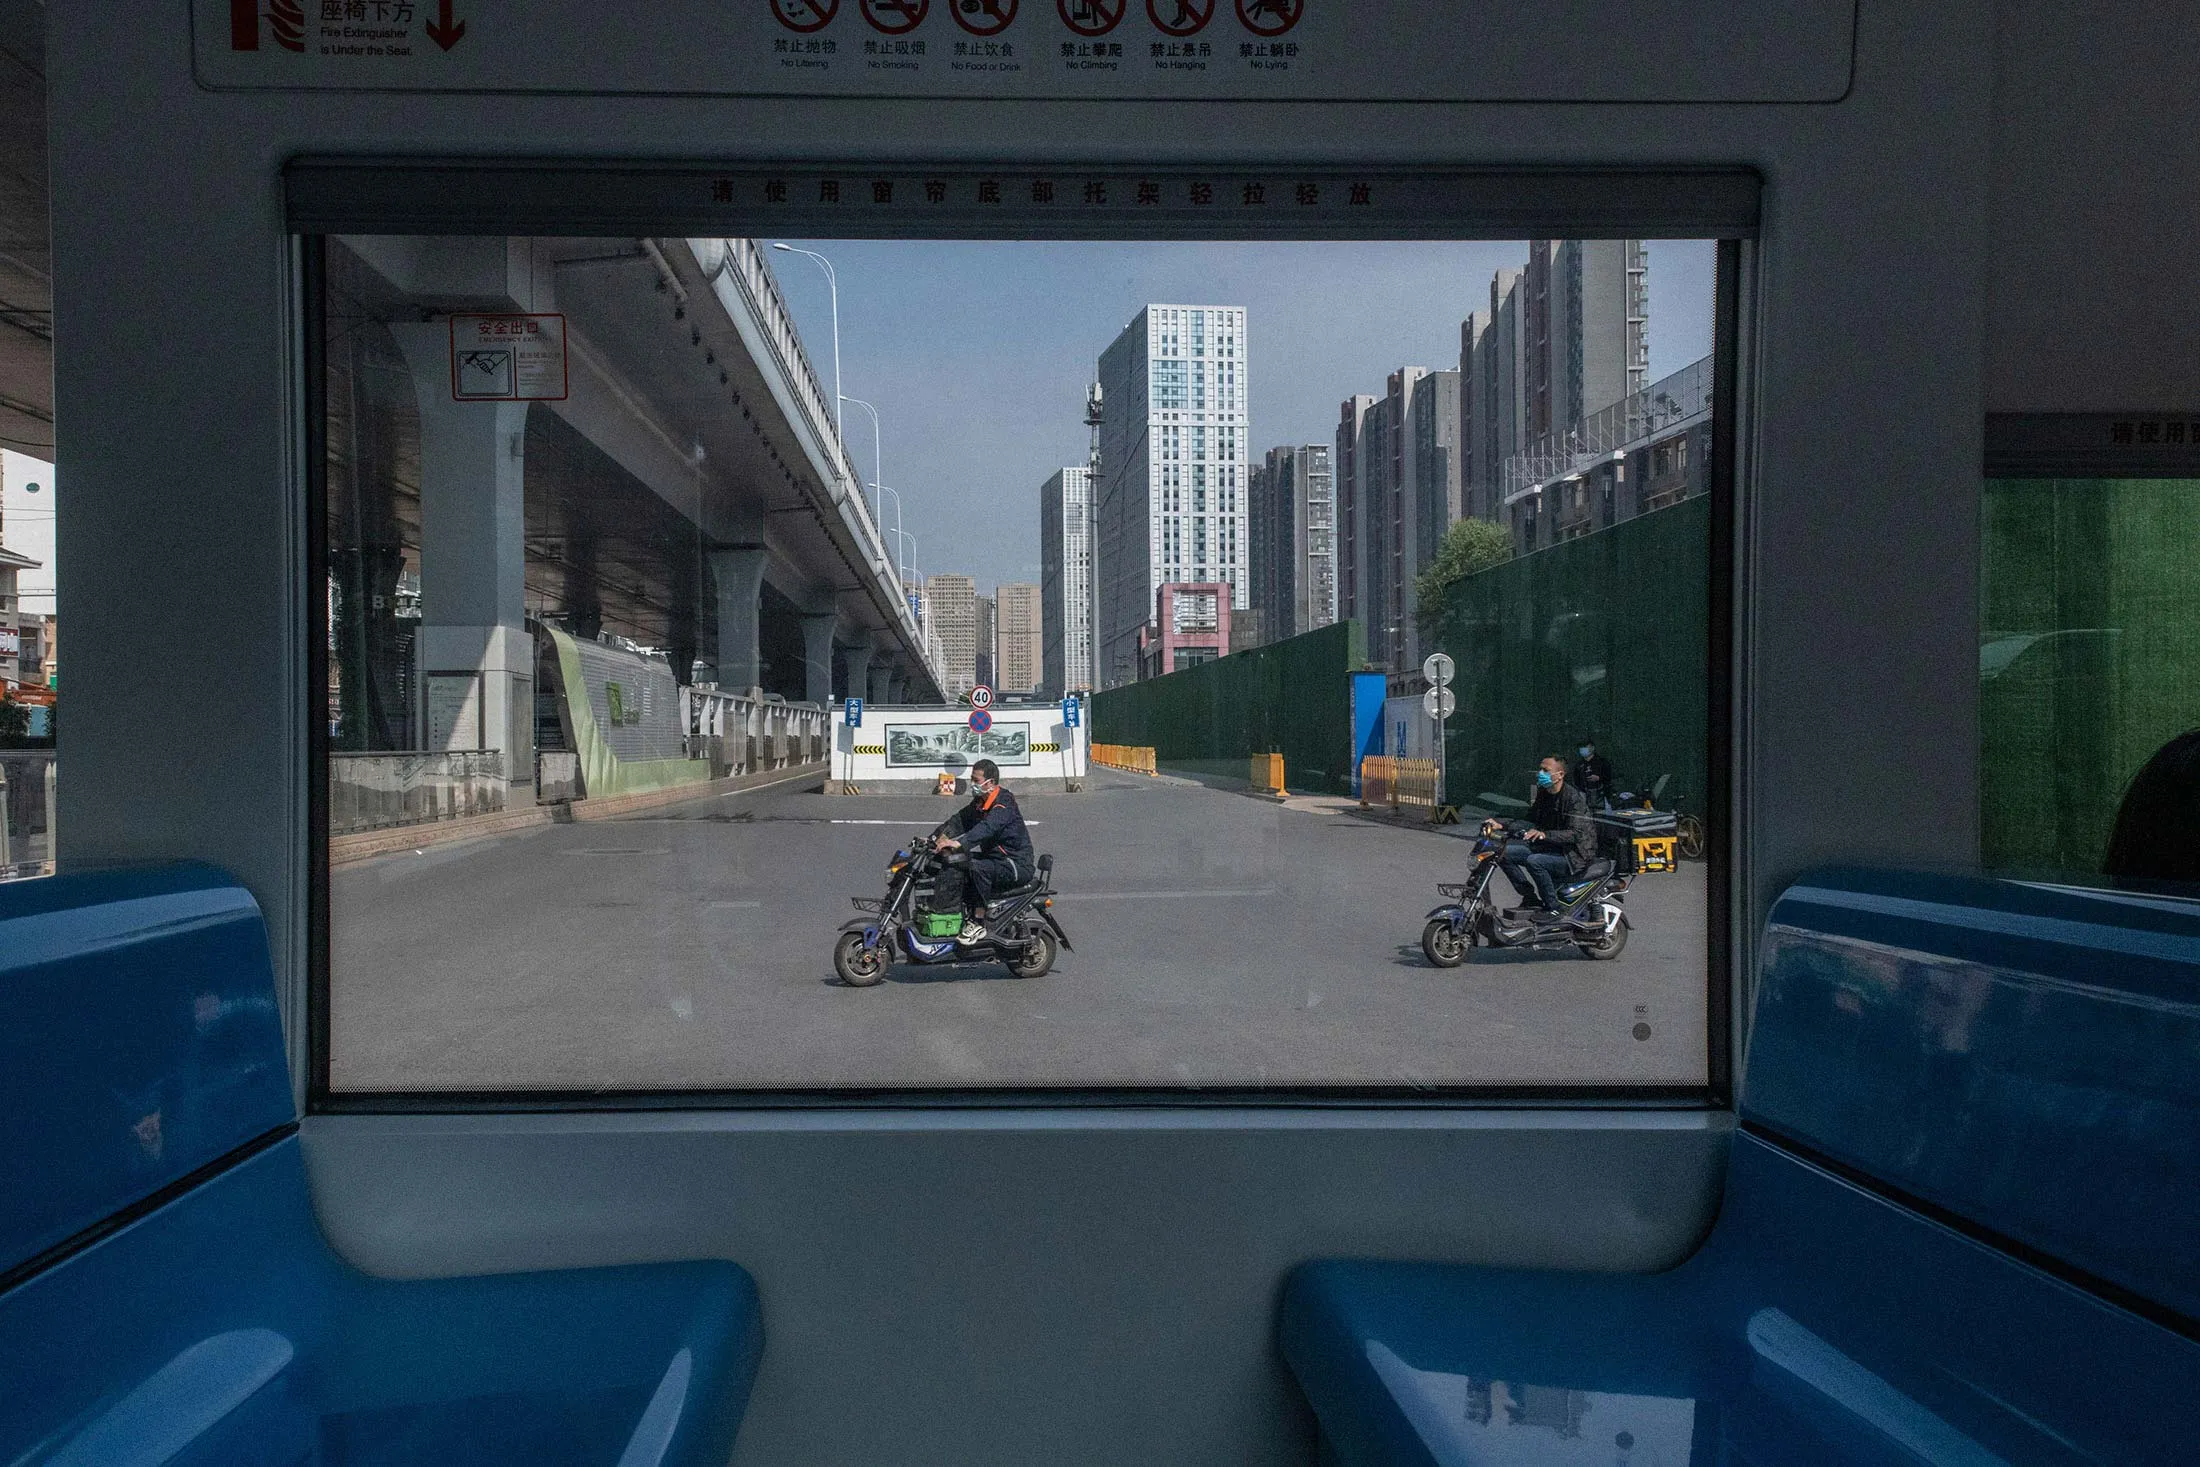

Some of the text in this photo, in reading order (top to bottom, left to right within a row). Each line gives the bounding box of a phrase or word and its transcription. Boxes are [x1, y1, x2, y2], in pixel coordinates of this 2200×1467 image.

[320, 0, 414, 22] 座椅下方
[320, 27, 408, 40] Fire Extinguisher
[320, 45, 329, 56] is
[332, 45, 364, 56] Under
[367, 45, 383, 56] the
[774, 39, 836, 54] 禁止抛物
[863, 40, 926, 55] 禁止吸烟
[953, 42, 1014, 57] 禁止饮食
[1060, 43, 1122, 58] 禁止攀爬
[1150, 43, 1211, 58] 禁止悬吊
[1239, 43, 1299, 58] 禁止躺卧
[781, 59, 829, 70] No Littering
[868, 61, 919, 71] No Smoking
[951, 62, 1021, 72] No Food or Drink
[1066, 61, 1118, 71] No Climbing
[1155, 61, 1206, 71] No Hanging
[1250, 61, 1288, 71] No Lying
[479, 321, 538, 335] 安全出口
[974, 691, 989, 703] 40
